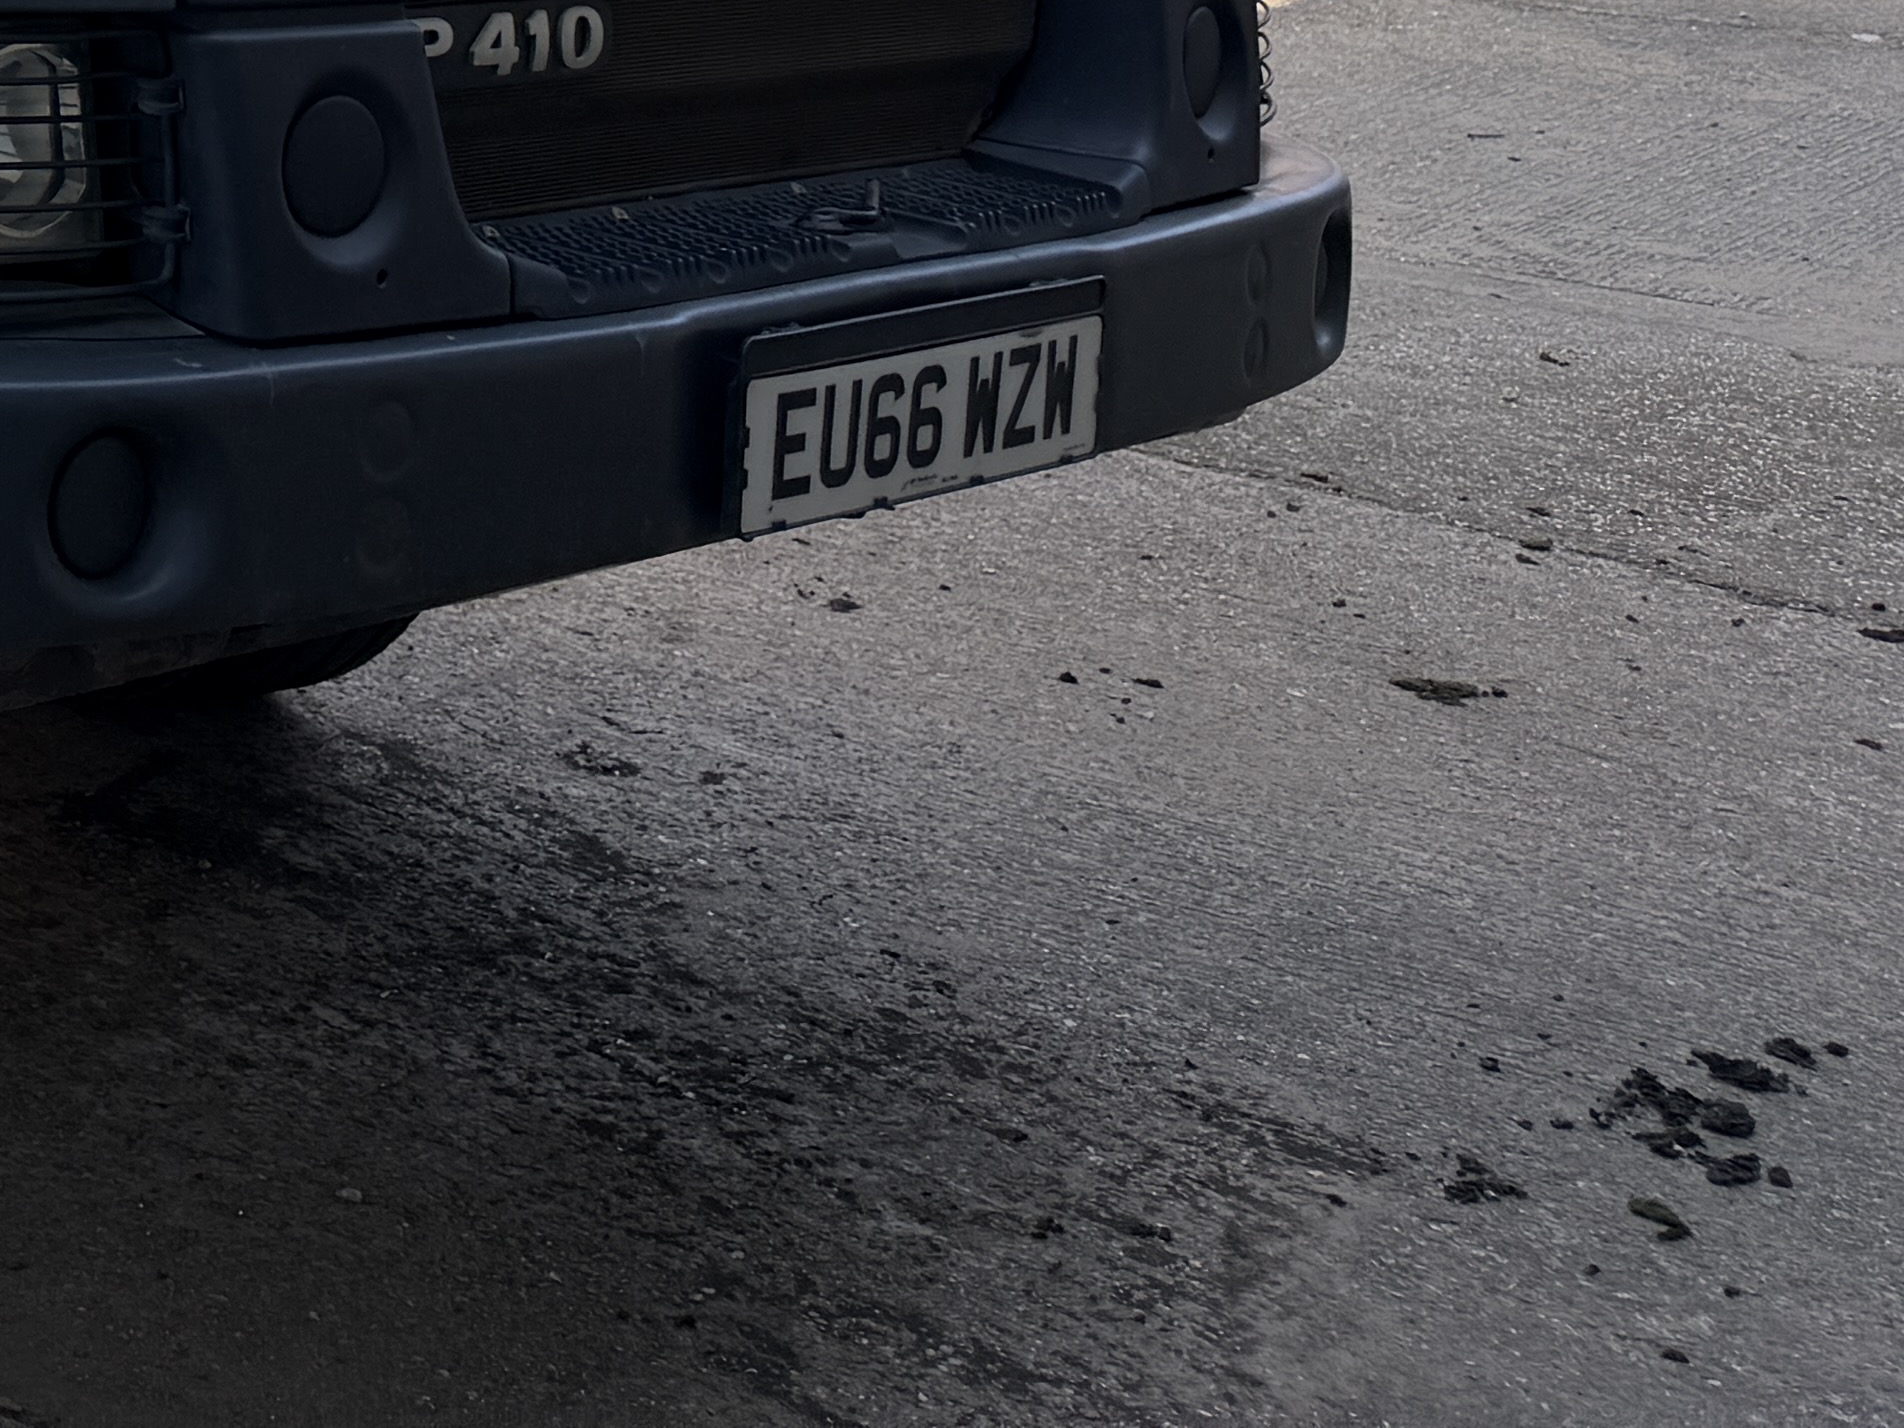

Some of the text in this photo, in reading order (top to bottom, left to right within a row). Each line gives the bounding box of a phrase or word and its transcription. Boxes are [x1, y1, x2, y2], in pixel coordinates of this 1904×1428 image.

[469, 5, 605, 76] 410
[772, 337, 1078, 500] EU66 WZW
